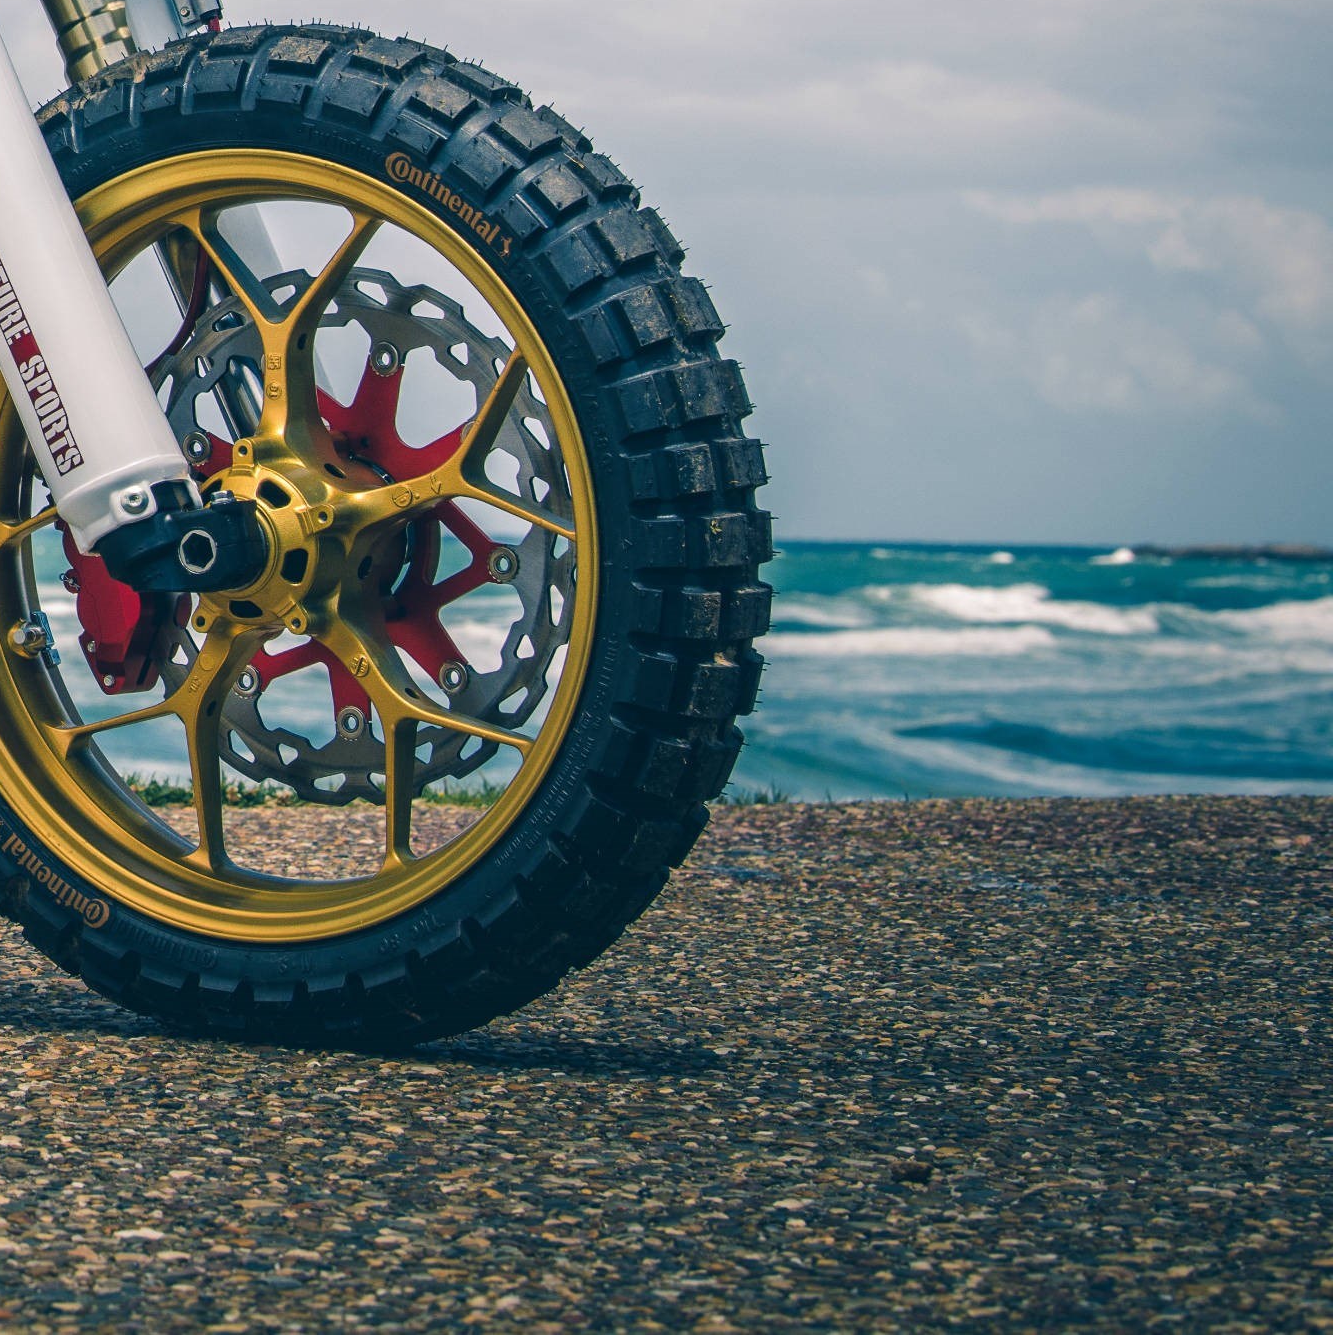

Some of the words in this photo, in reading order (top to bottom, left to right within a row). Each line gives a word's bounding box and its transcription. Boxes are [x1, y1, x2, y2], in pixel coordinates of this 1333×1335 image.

[385, 151, 501, 245] Continental
[20, 355, 83, 476] SPORTS
[2, 832, 110, 928] Continental
